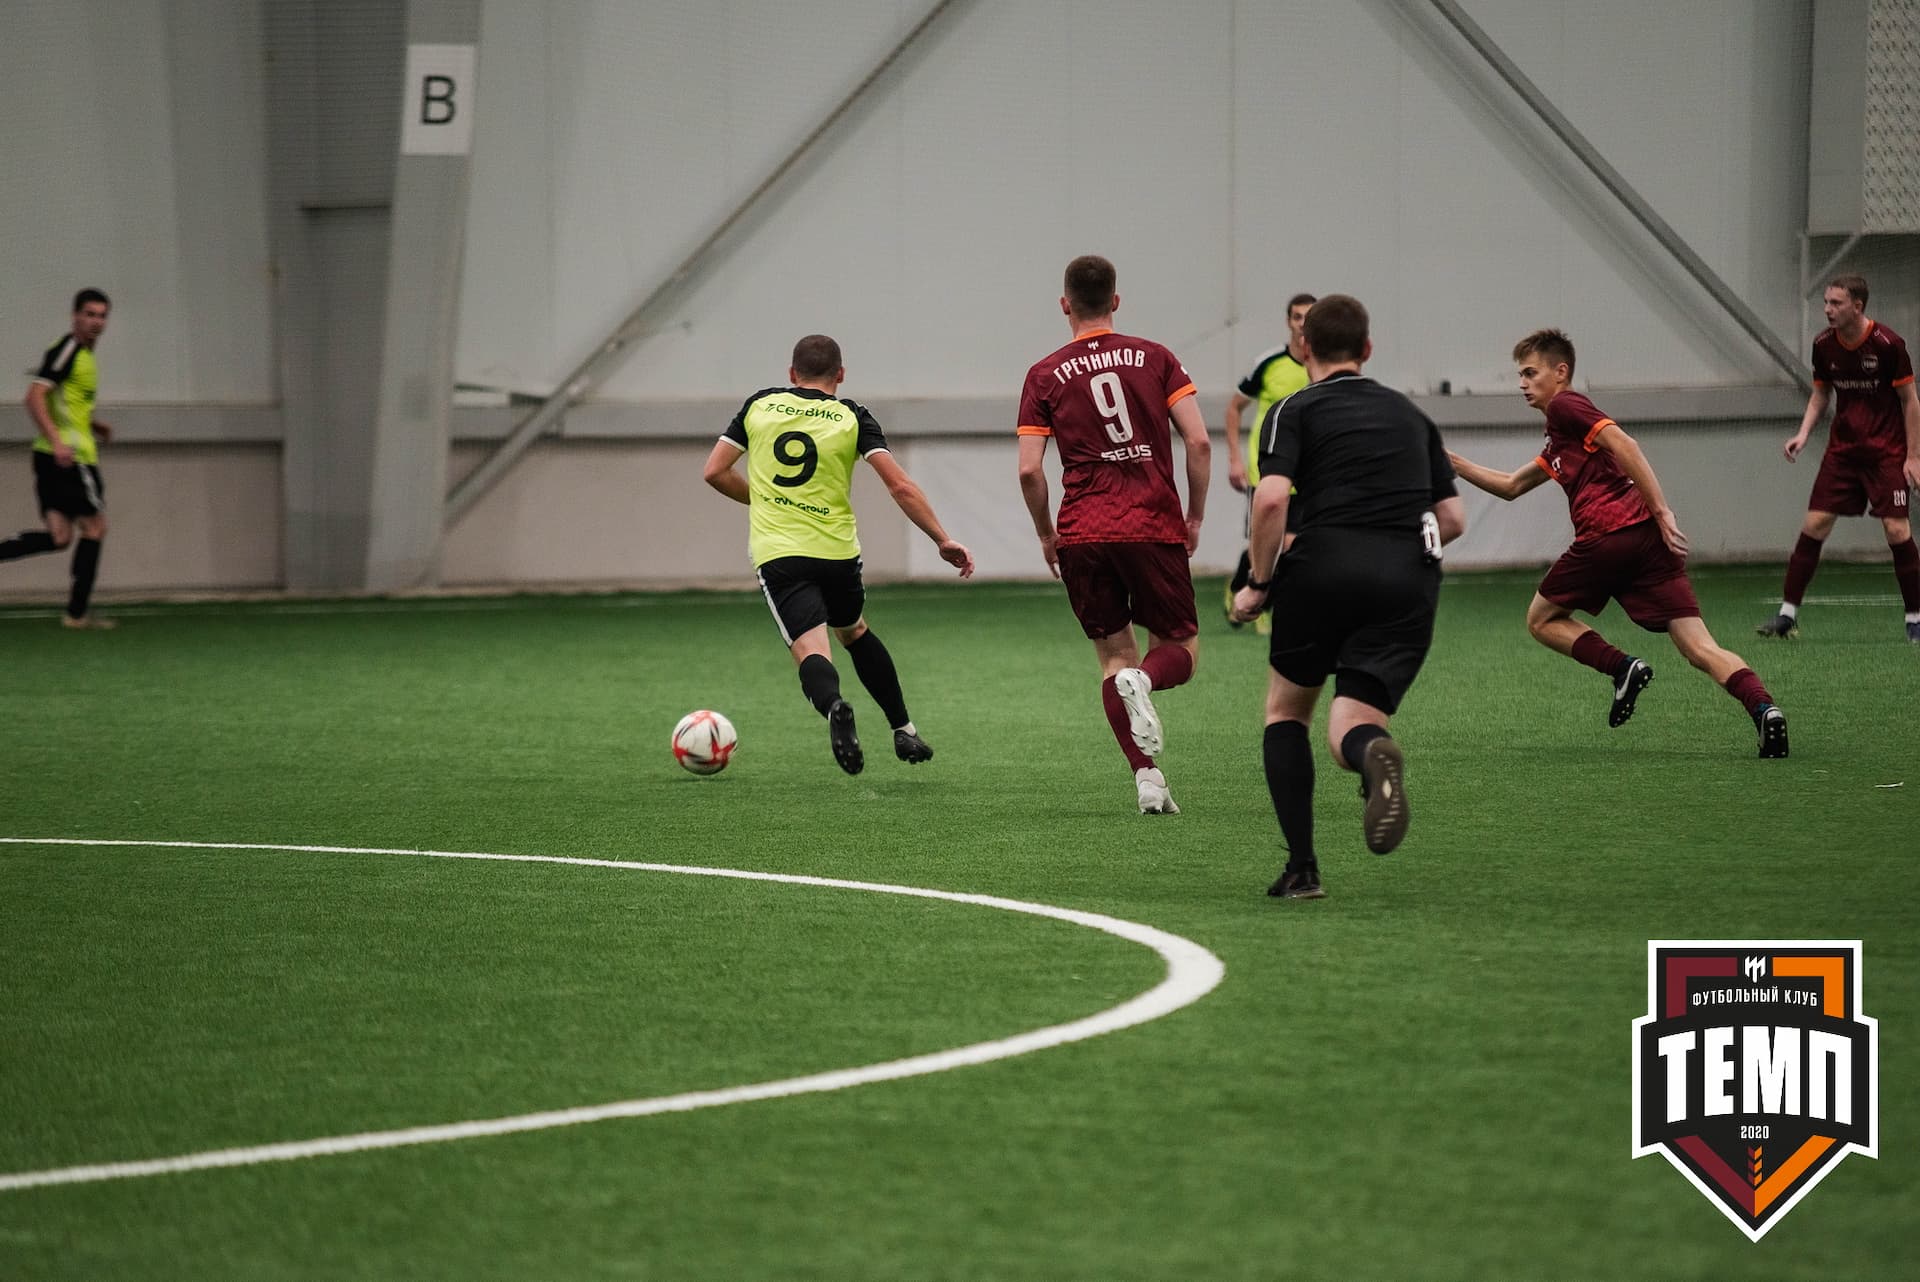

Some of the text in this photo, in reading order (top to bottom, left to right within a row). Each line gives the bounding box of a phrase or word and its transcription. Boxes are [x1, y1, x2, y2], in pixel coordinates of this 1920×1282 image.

[1053, 348, 1146, 384] ГРЕЧНИКОВ
[1090, 372, 1134, 444] 9
[772, 431, 818, 487] 9
[1101, 444, 1152, 462] SEUS
